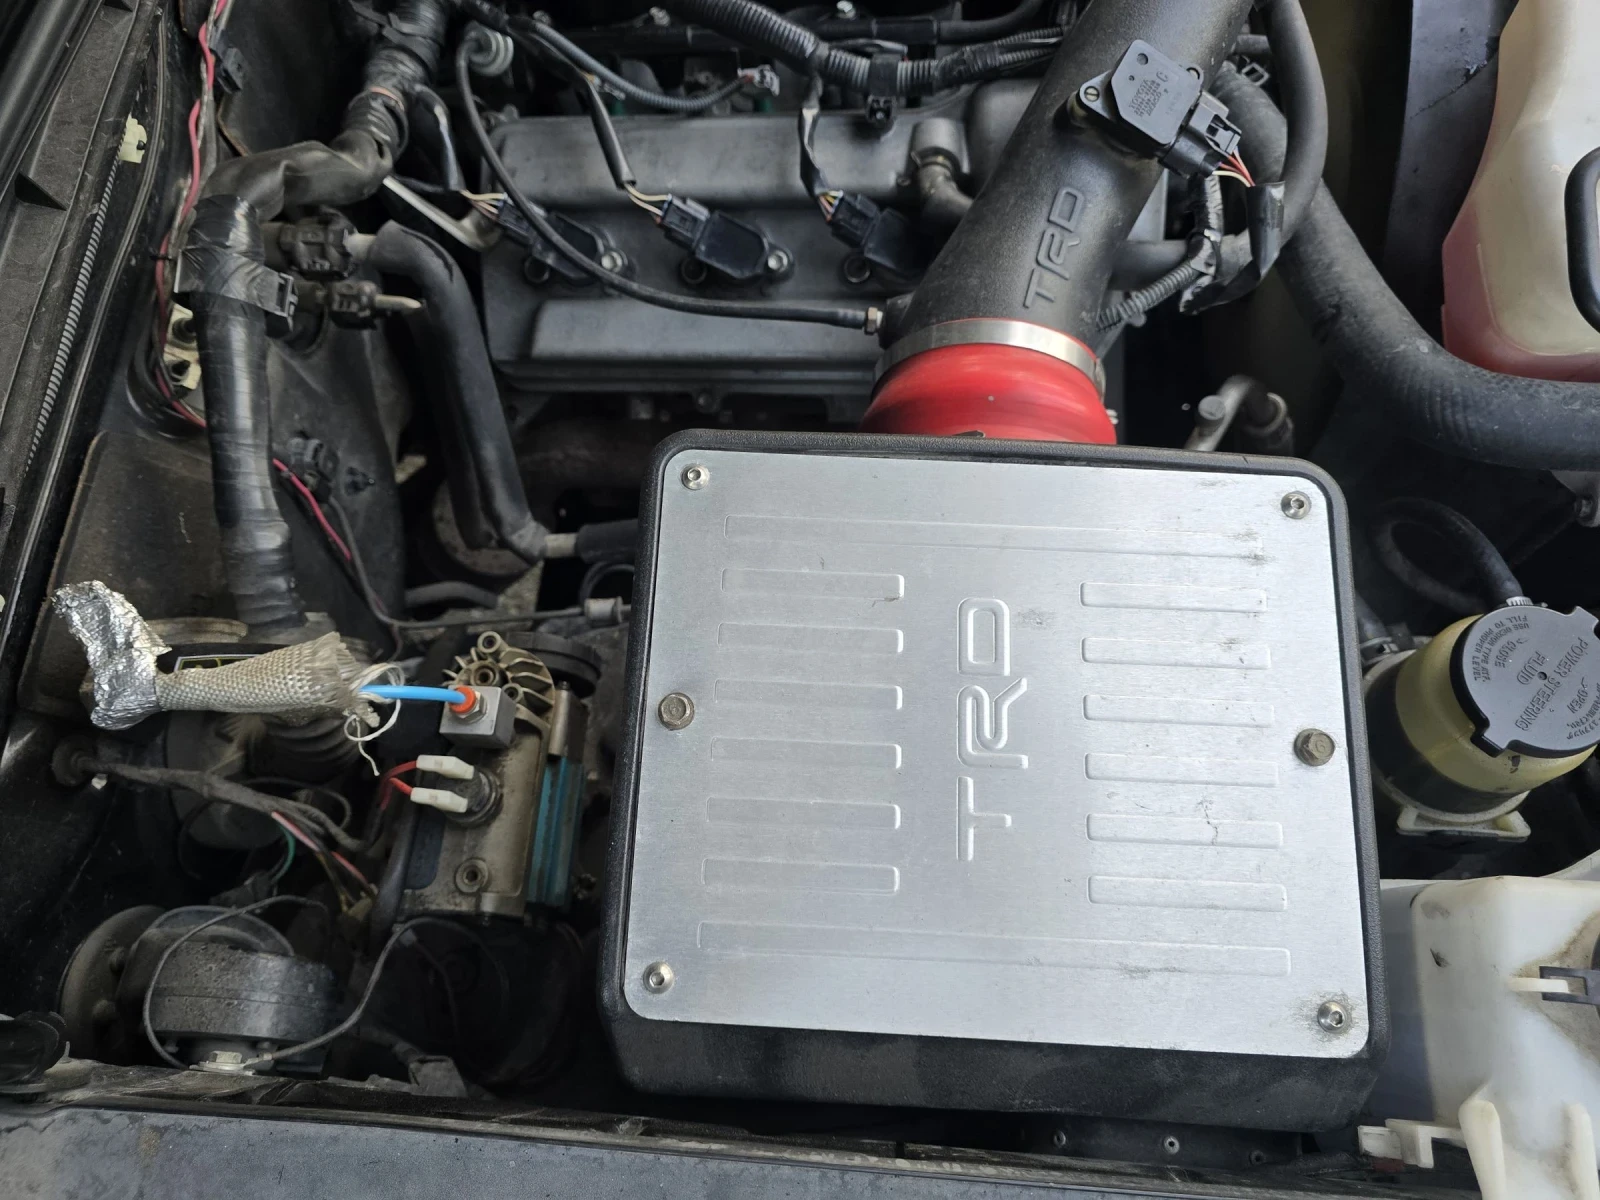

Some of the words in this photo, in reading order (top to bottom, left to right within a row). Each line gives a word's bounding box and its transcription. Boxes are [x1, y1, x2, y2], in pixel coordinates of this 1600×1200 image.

[1128, 79, 1150, 108] TOYOTA
[1146, 92, 1162, 116] DENSO
[1023, 187, 1084, 309] TRD
[1494, 620, 1506, 629] TO
[1505, 615, 1528, 623] FILL
[1474, 627, 1494, 654] PROPER
[1494, 640, 1517, 668] CLOSE
[1472, 655, 1481, 681] LEVEL
[1481, 646, 1492, 665] TYPE
[1516, 651, 1546, 685] FLUID
[1553, 636, 1589, 678] POWER
[1515, 675, 1560, 731] STEERING
[1566, 689, 1588, 714] OPEN
[957, 597, 1028, 861] TRD
